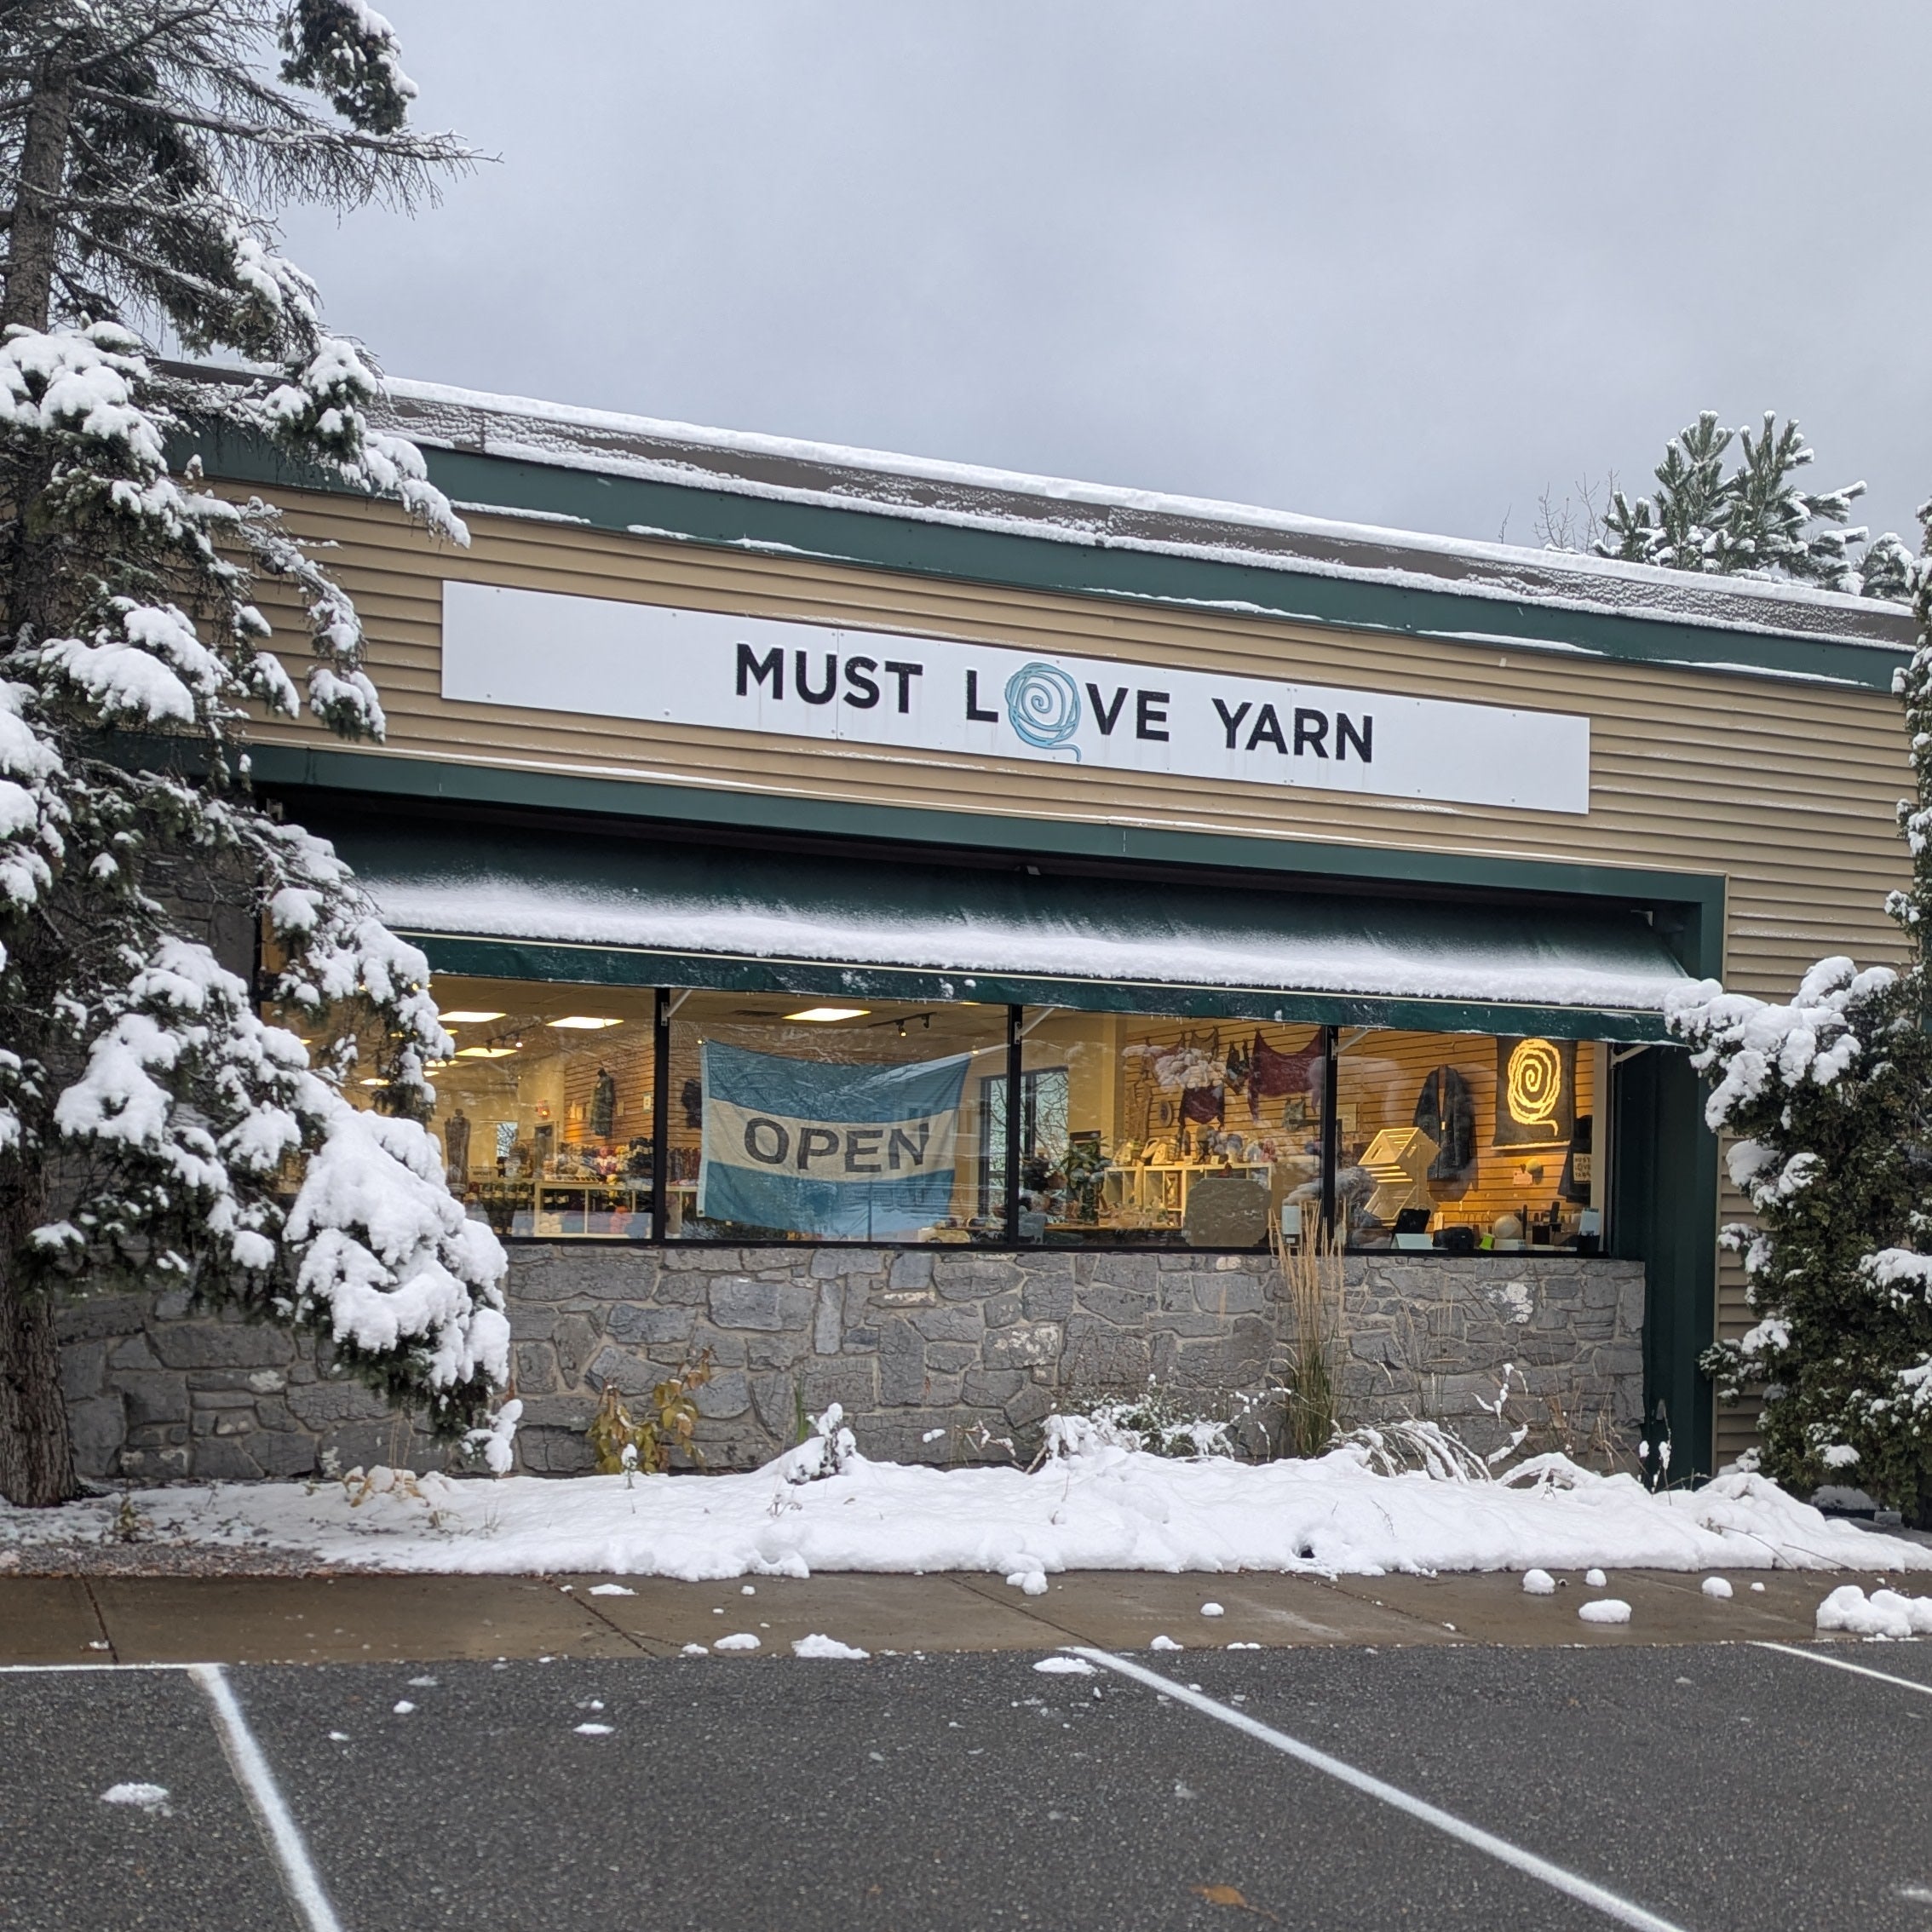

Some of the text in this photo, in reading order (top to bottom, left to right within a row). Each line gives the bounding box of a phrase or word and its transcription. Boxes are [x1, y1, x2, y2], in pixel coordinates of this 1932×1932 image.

[736, 643, 1372, 763] MUST LOVE YARN
[744, 1117, 929, 1173] OPEN
